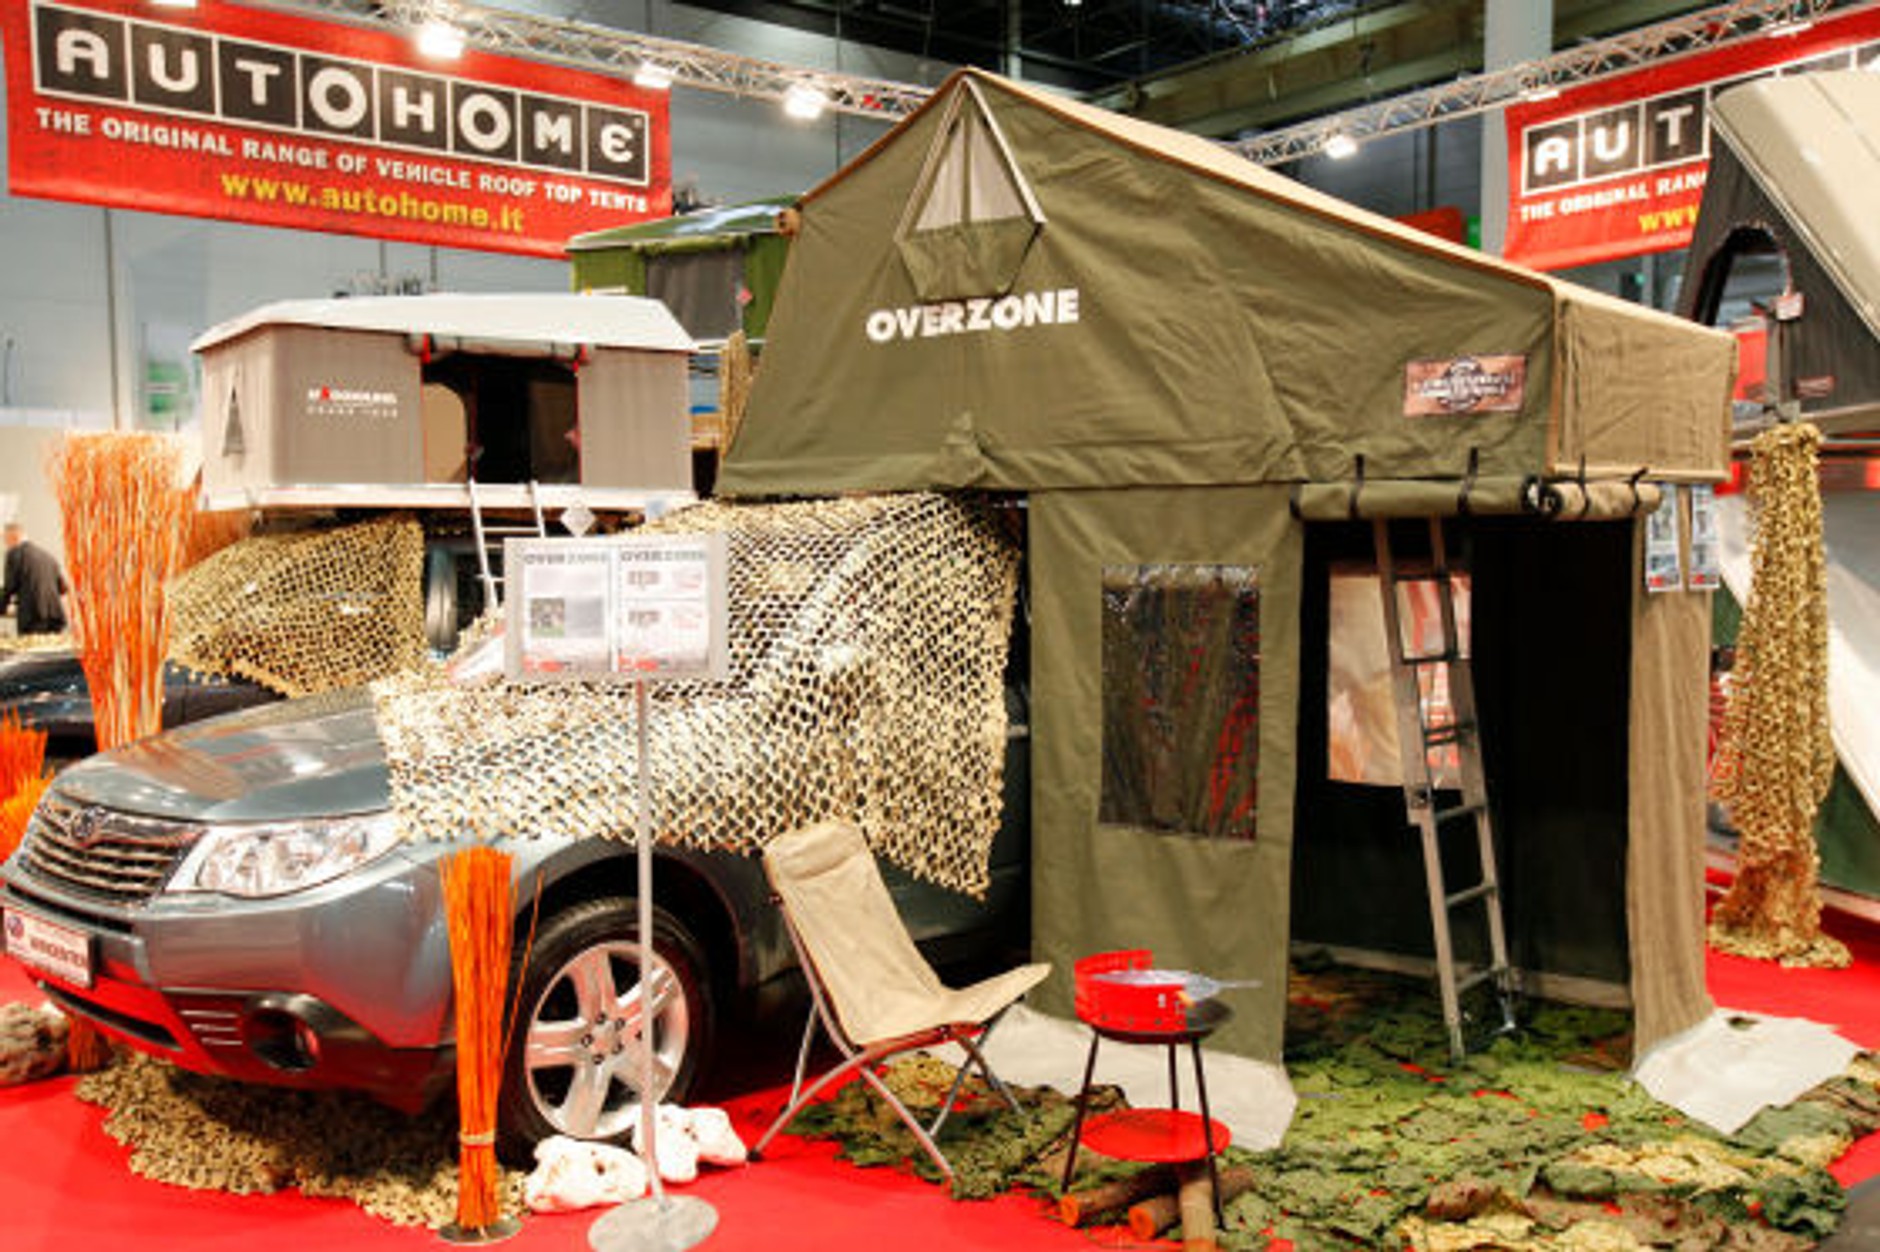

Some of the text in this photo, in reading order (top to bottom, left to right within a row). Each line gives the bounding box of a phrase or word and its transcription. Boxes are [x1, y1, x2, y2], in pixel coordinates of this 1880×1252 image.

[56, 28, 635, 163] AUTOHOME
[36, 107, 648, 214] THE ORIGINAL RANGE OF VEHICLE ROOF TOP TENTS
[1534, 104, 1694, 177] AUT
[220, 173, 525, 232] www.autohome.it
[1521, 201, 1554, 223] THE
[1559, 183, 1649, 216] ORIGINAL
[866, 288, 1079, 342] OVERZONE
